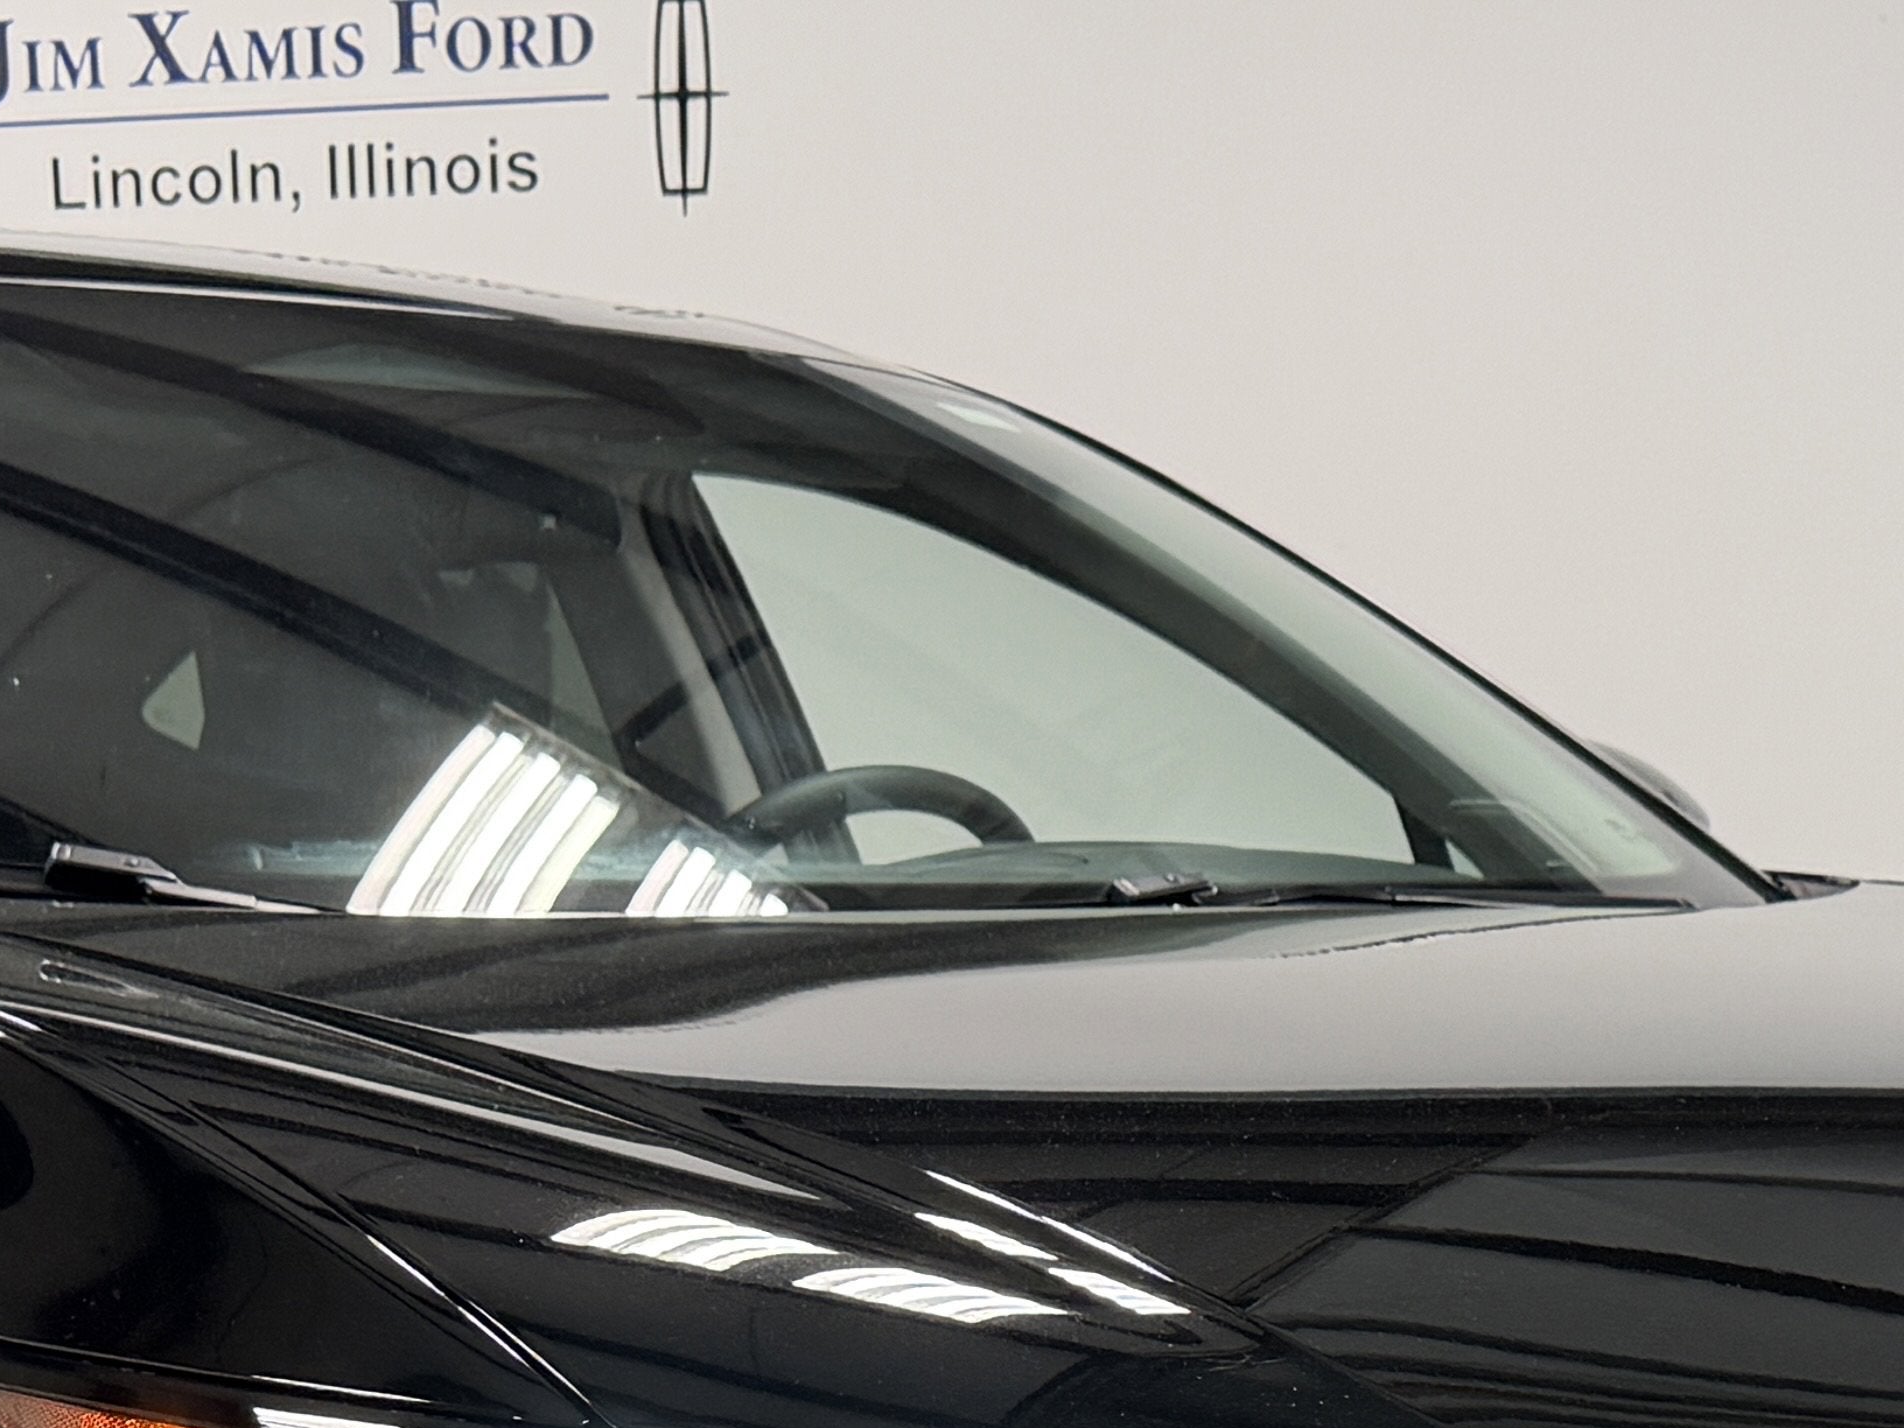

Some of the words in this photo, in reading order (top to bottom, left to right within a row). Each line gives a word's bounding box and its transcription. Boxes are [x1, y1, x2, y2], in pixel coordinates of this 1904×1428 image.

[128, 9, 365, 88] XAMIS
[392, 0, 595, 75] FORD
[50, 148, 303, 213] Lincoln,
[328, 137, 540, 201] Illinois
